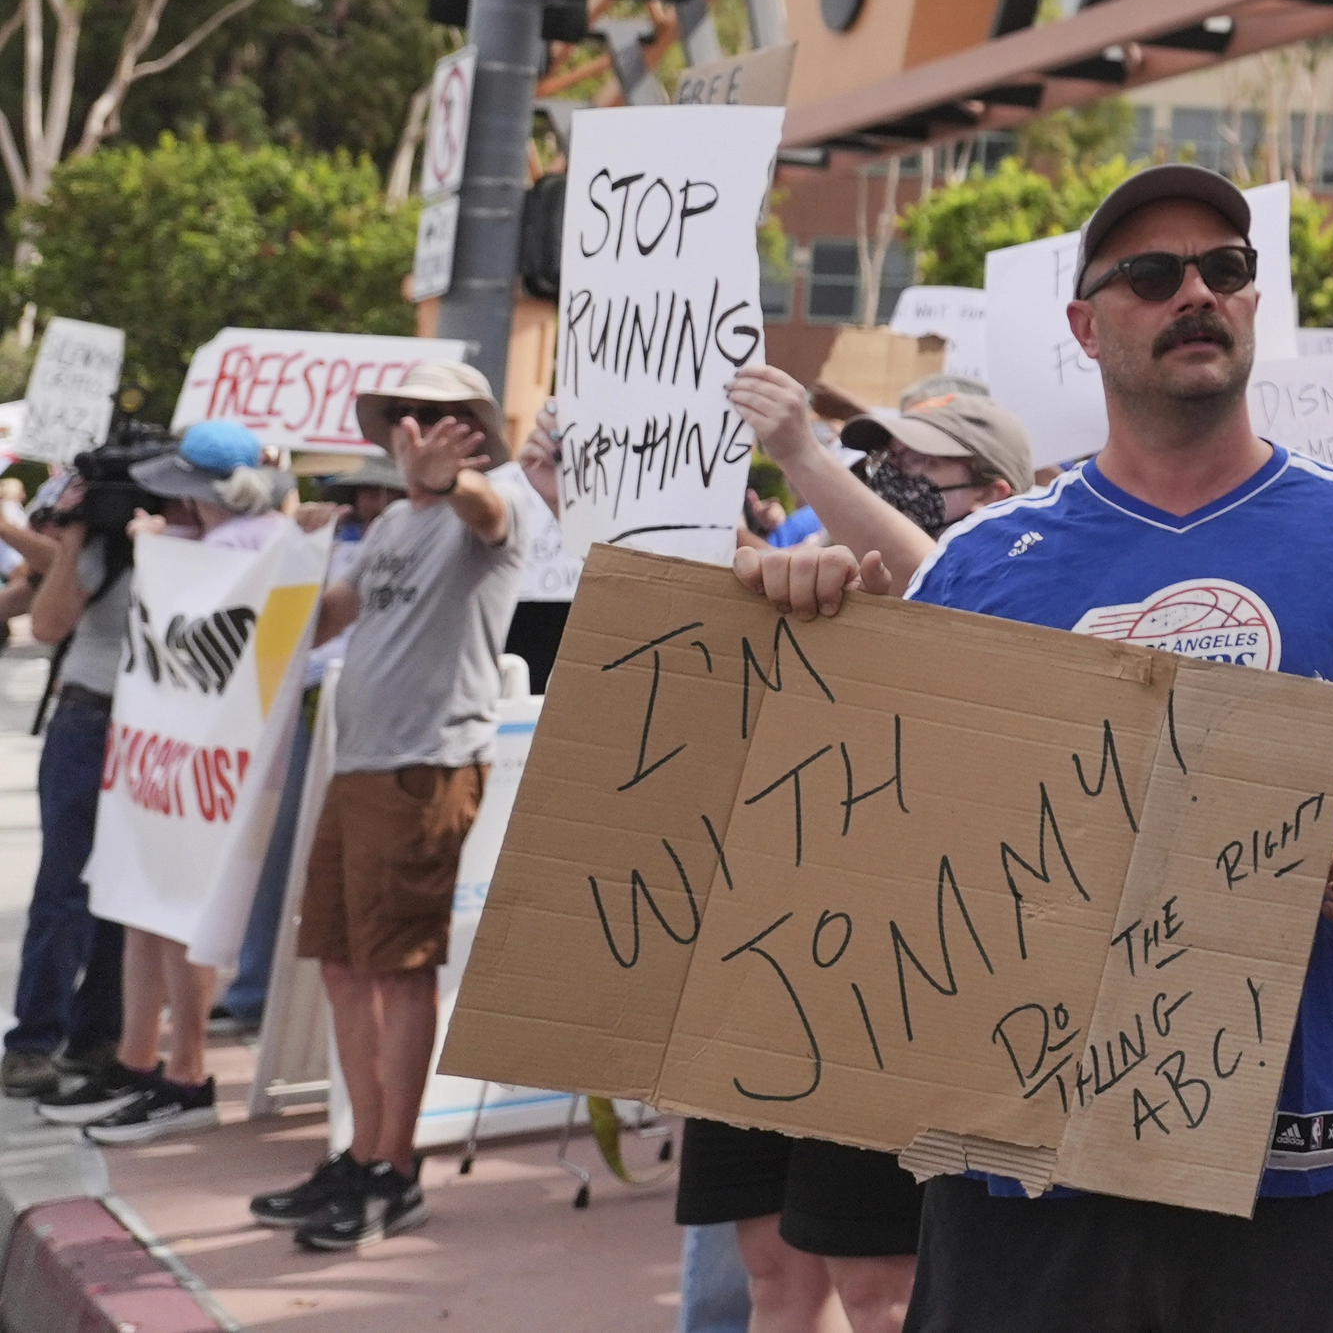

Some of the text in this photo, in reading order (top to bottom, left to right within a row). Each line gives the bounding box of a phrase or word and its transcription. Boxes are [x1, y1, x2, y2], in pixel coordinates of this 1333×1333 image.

[580, 168, 719, 263] STOP
[563, 277, 760, 399] RUINING
[601, 617, 835, 791] I'M
[1172, 632, 1259, 654] ANGELES
[589, 713, 910, 969] WITH
[1111, 895, 1185, 977] THE
[1216, 793, 1326, 890] RIGHT
[1133, 977, 1267, 1140] ABC!
[1276, 1136, 1306, 1147] adidas
